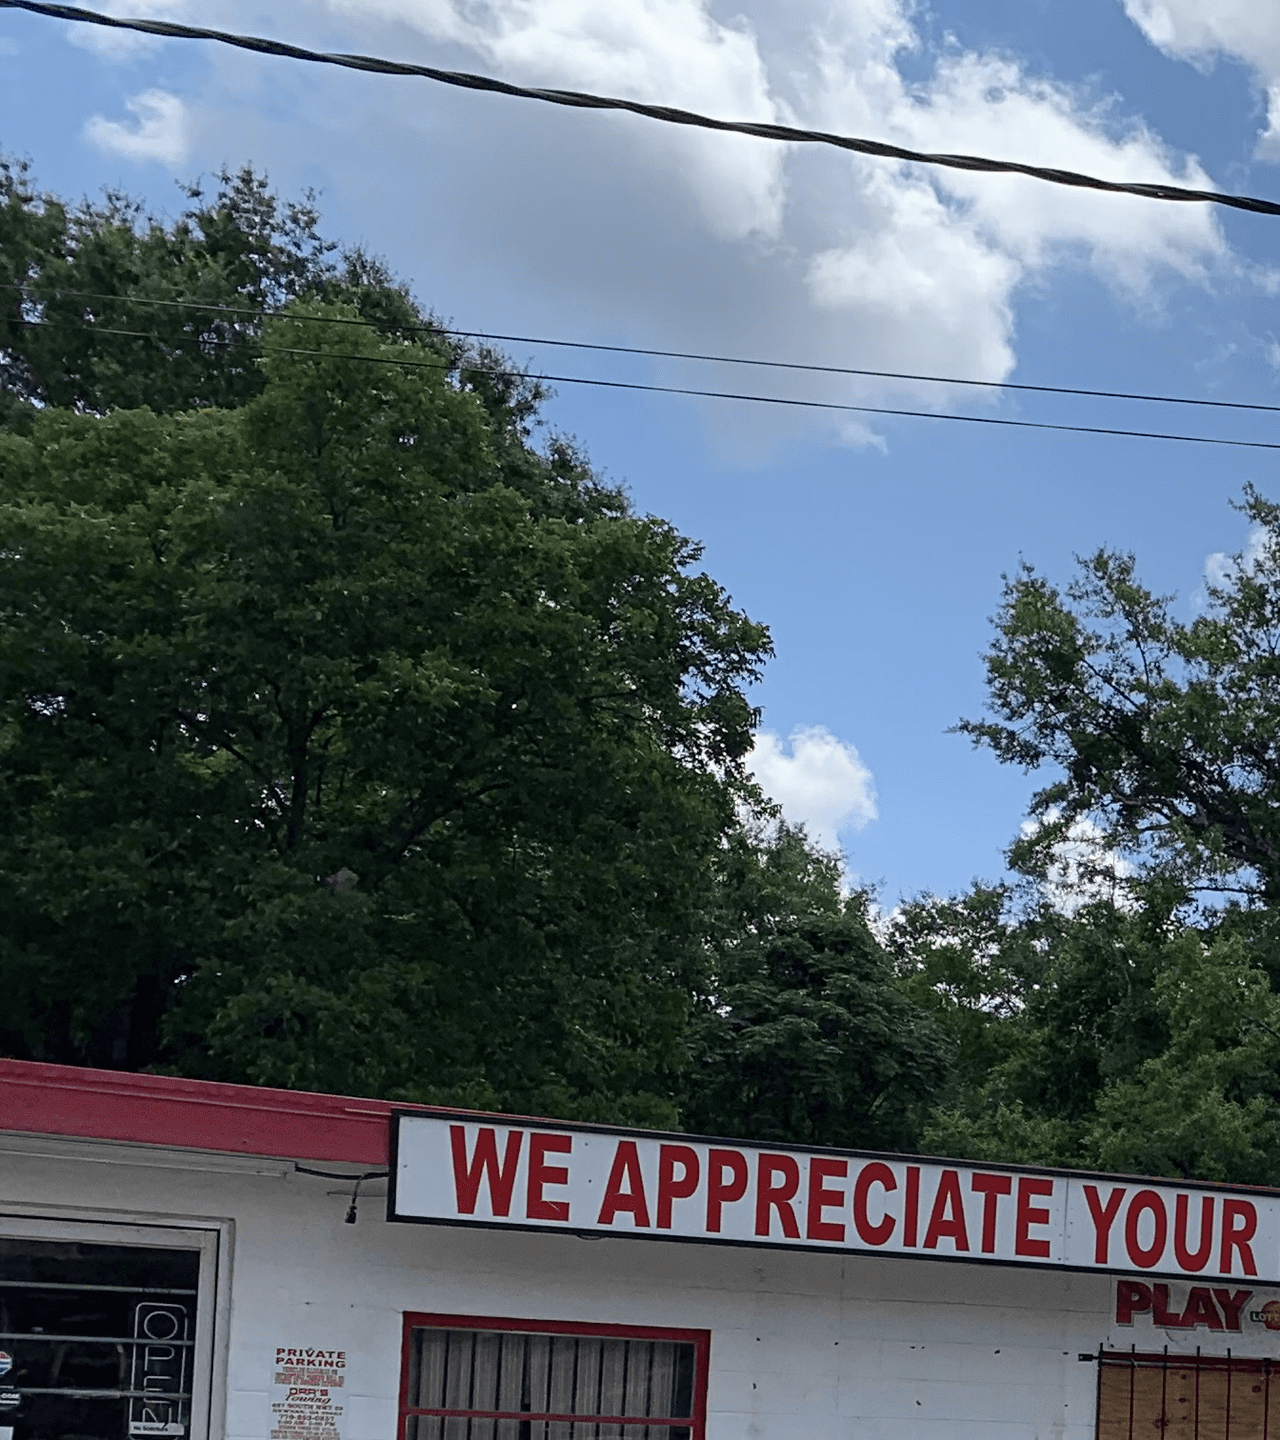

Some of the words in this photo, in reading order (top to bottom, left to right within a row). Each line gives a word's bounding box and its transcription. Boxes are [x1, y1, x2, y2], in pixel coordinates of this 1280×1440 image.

[449, 1124, 573, 1222] WE
[597, 1139, 1054, 1259] APPRECIATE
[1082, 1184, 1258, 1277] YOUR
[1116, 1279, 1254, 1331] PLAY
[275, 1356, 346, 1369] PARKING
[276, 1347, 346, 1360] PRIVATE
